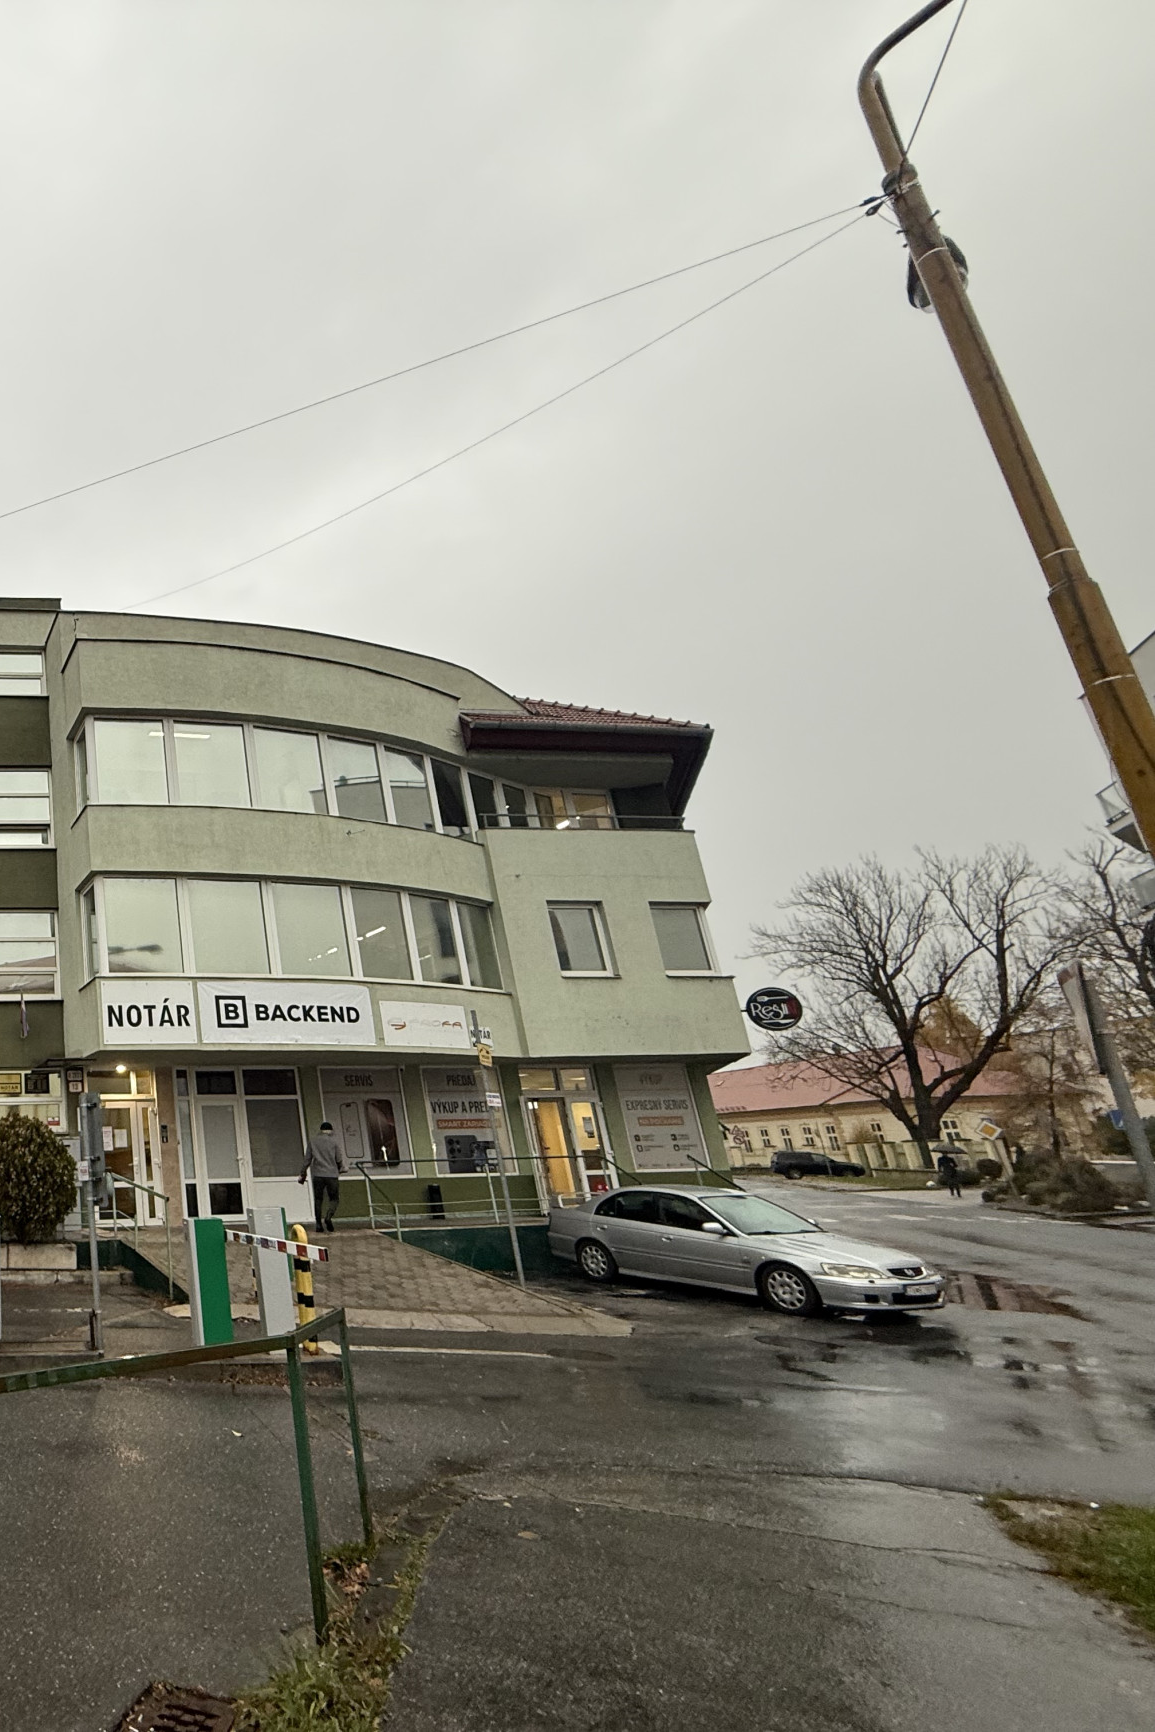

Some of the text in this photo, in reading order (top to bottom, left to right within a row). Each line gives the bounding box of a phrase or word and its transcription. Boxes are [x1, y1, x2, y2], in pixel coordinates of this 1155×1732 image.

[107, 998, 190, 1027] NOTÁR
[255, 1004, 360, 1023] BACKEND
[470, 1027, 491, 1040] NTÁR
[344, 1074, 373, 1087] SERVIS
[430, 1098, 459, 1114] VÝKUP
[461, 1101, 468, 1113] A
[663, 1099, 689, 1110] SERVIS
